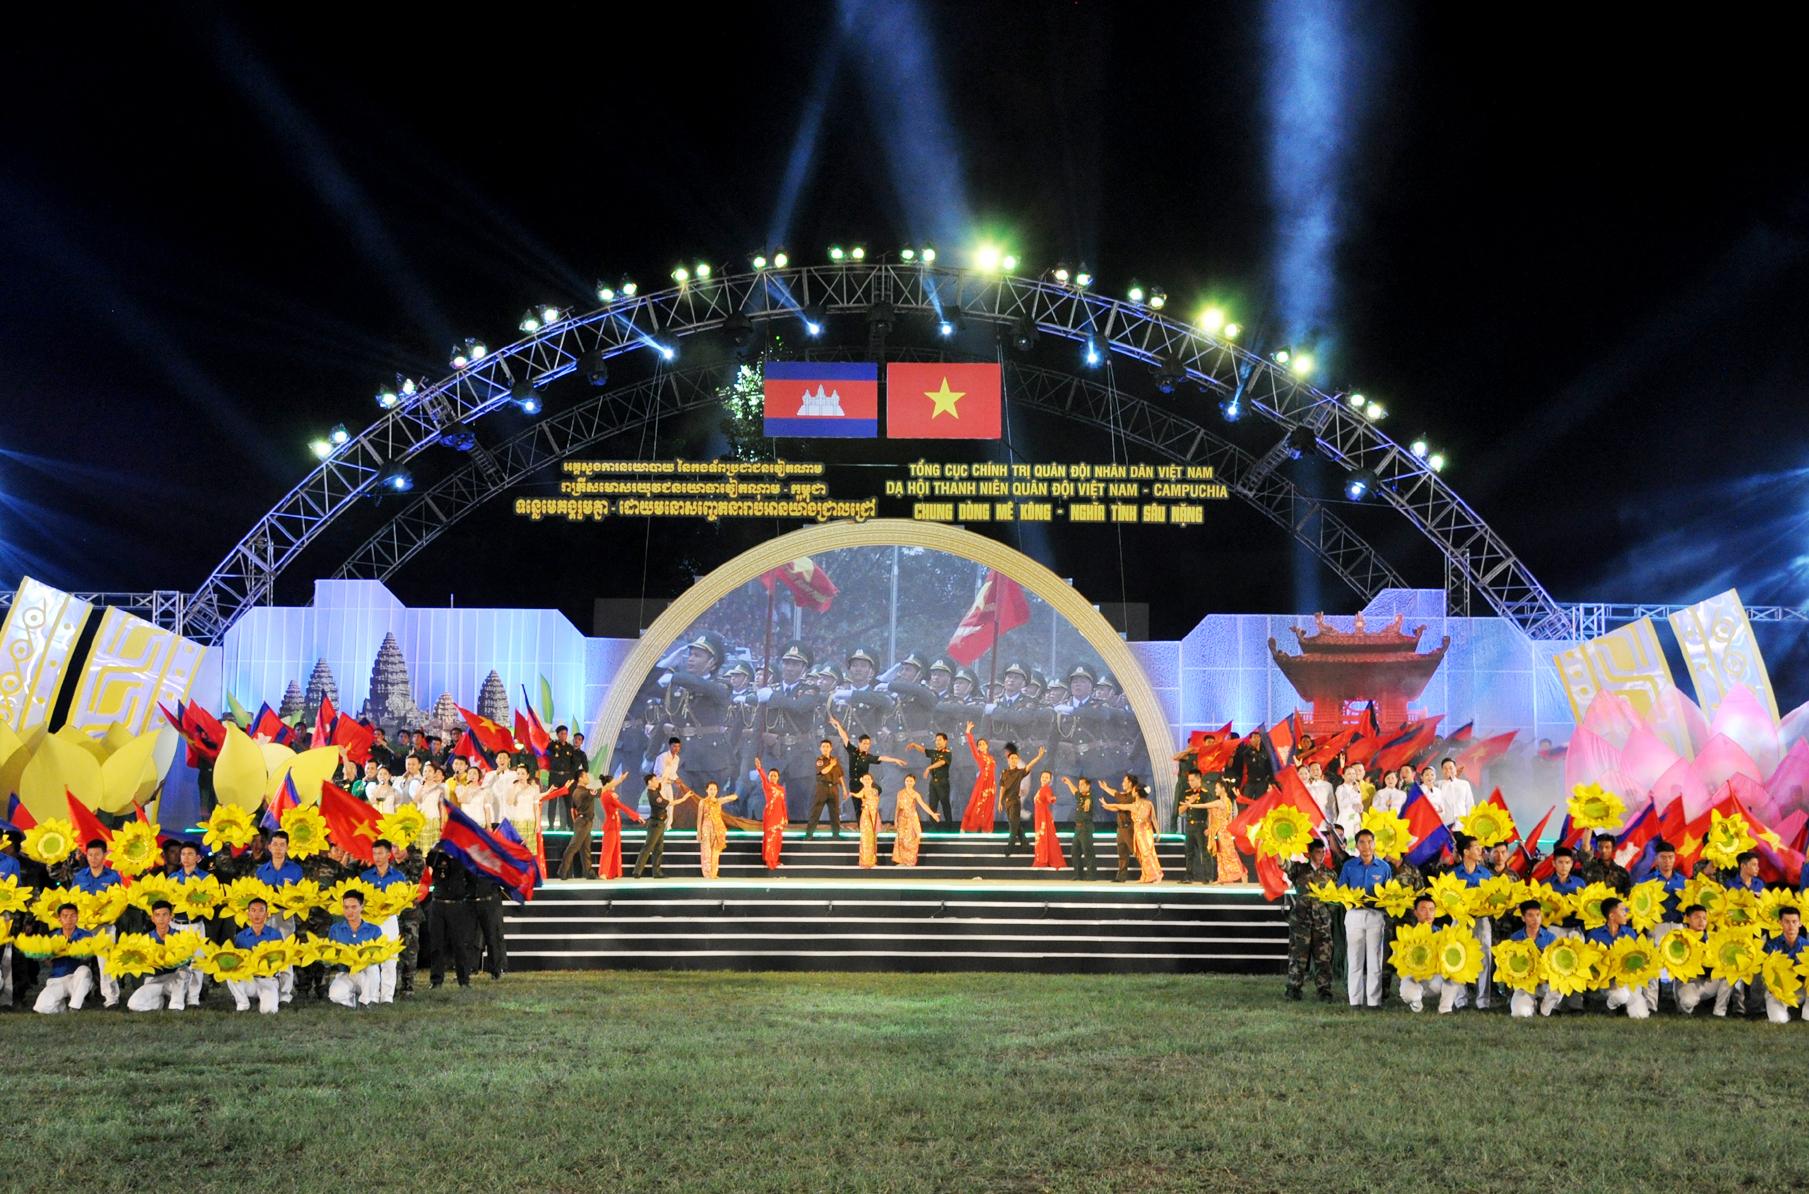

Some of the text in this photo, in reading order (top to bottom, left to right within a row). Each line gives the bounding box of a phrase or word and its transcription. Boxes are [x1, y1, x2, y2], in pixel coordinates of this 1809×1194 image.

[945, 464, 968, 479] CỤC
[973, 461, 1007, 476] CHÍNH
[1012, 464, 1031, 479] TRỊ
[1035, 463, 1066, 478] QUÂN
[1071, 463, 1091, 479] ĐỘI
[1095, 464, 1126, 478] NHÂN
[1131, 464, 1154, 478] DÂN
[1158, 464, 1182, 480] VIỆT
[1188, 467, 1213, 479] NAM
[886, 482, 904, 497] DẠ
[908, 479, 930, 498] HỘI
[934, 482, 976, 495] THANH
[980, 480, 1008, 495] NIÊN
[1013, 480, 1047, 496] QUÂN
[1052, 480, 1075, 498] ĐỘI
[1078, 480, 1105, 499] VIỆT
[1110, 484, 1138, 497] NAM
[1153, 484, 1229, 498] CAMPUCHIA
[914, 502, 953, 520] CHUNG
[959, 500, 990, 520] DÒNG
[996, 501, 1014, 520] MÊ
[1020, 501, 1052, 521] KÔNG
[1070, 502, 1105, 521] NGHĨA
[1111, 502, 1138, 521] TÌNH
[1143, 503, 1166, 522] SÂU
[1171, 503, 1203, 526] NẶNG
